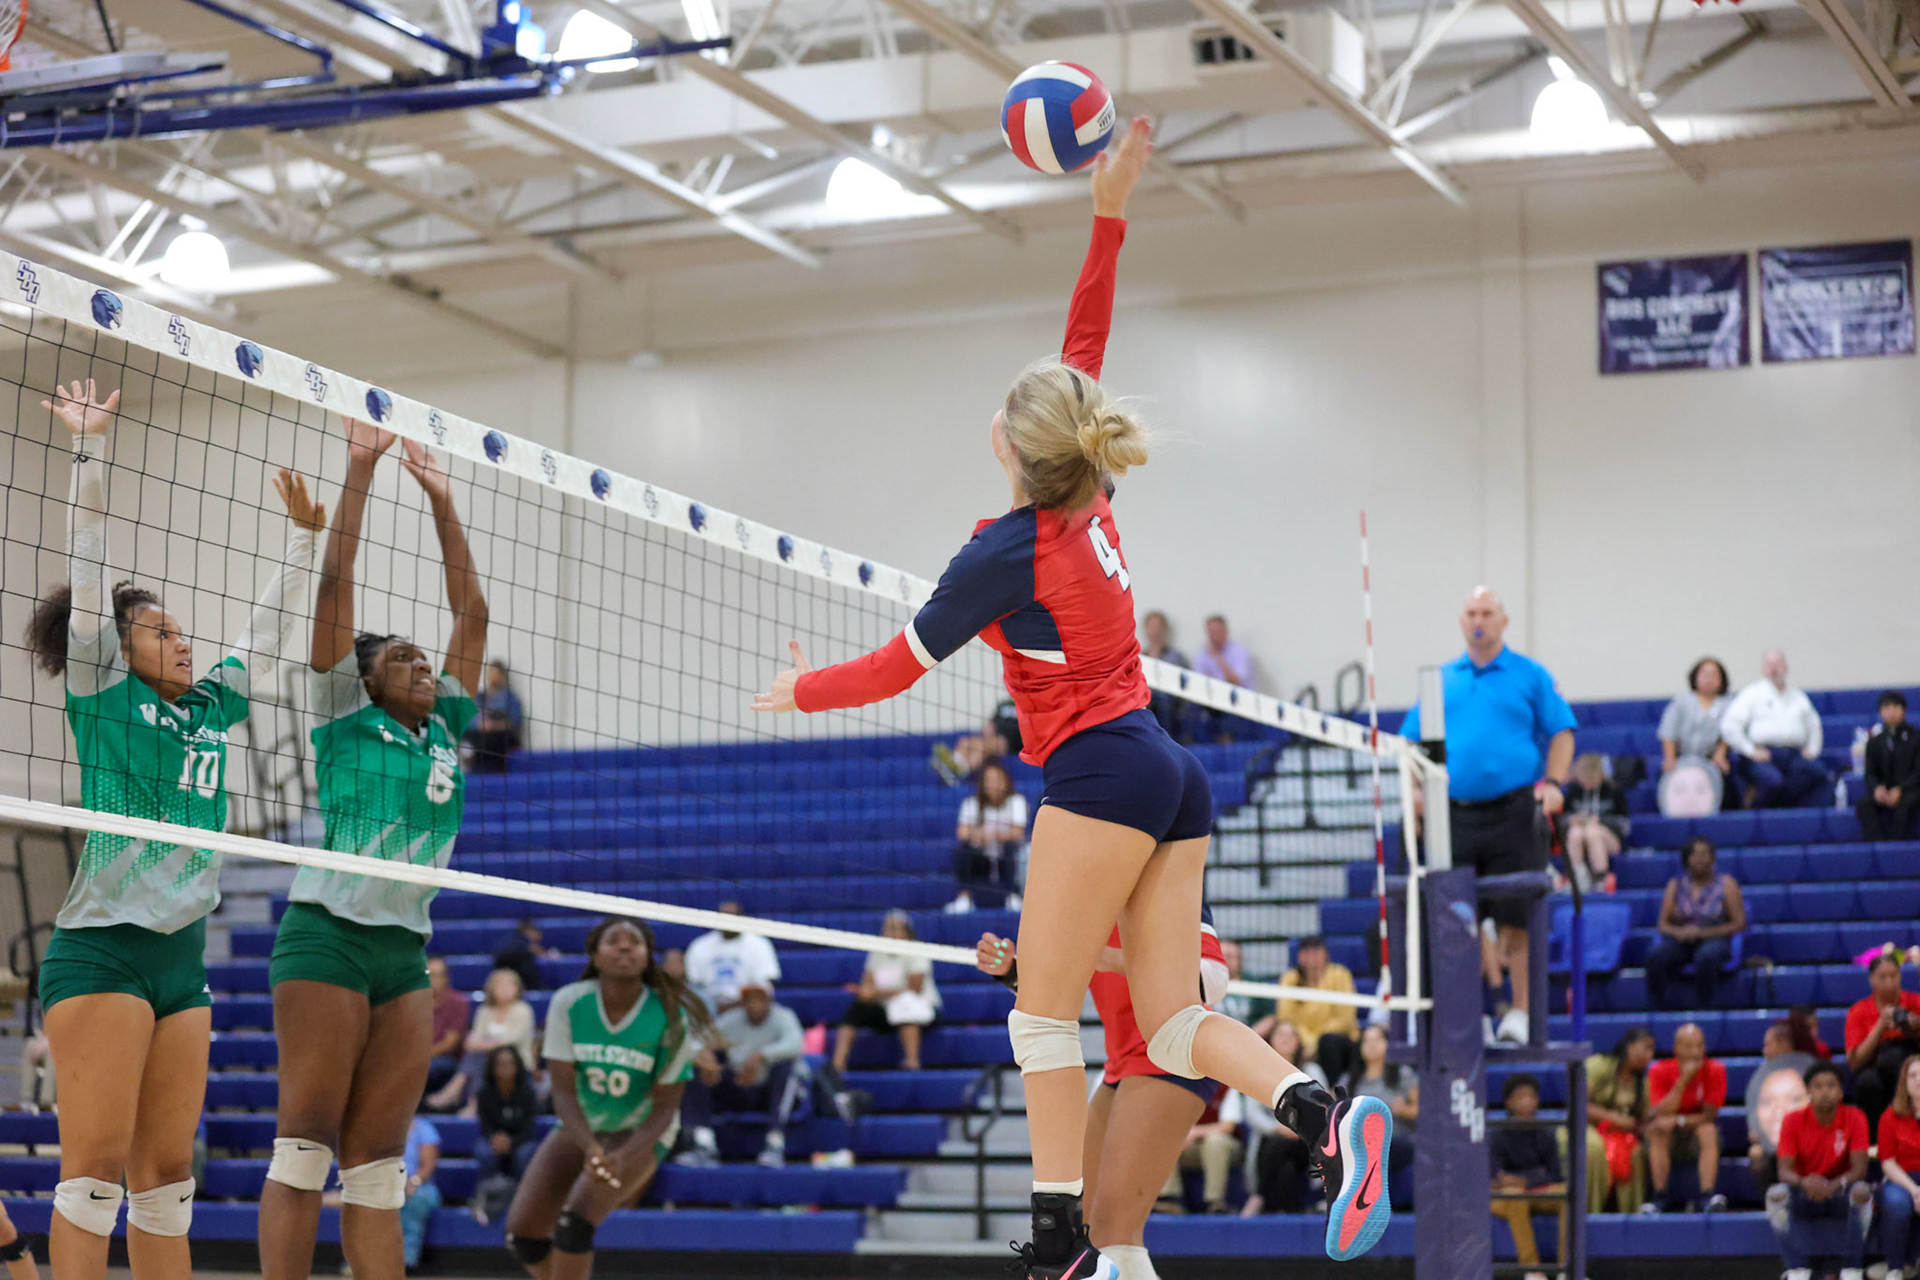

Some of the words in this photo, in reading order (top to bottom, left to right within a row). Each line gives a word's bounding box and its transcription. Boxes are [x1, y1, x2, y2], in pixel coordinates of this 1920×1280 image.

[16, 260, 40, 304] SBA
[168, 314, 191, 356] SBA
[305, 363, 328, 402] SBA
[1087, 514, 1130, 594] 4
[177, 745, 220, 799] 10
[426, 760, 456, 805] 6
[586, 1066, 631, 1097] 20
